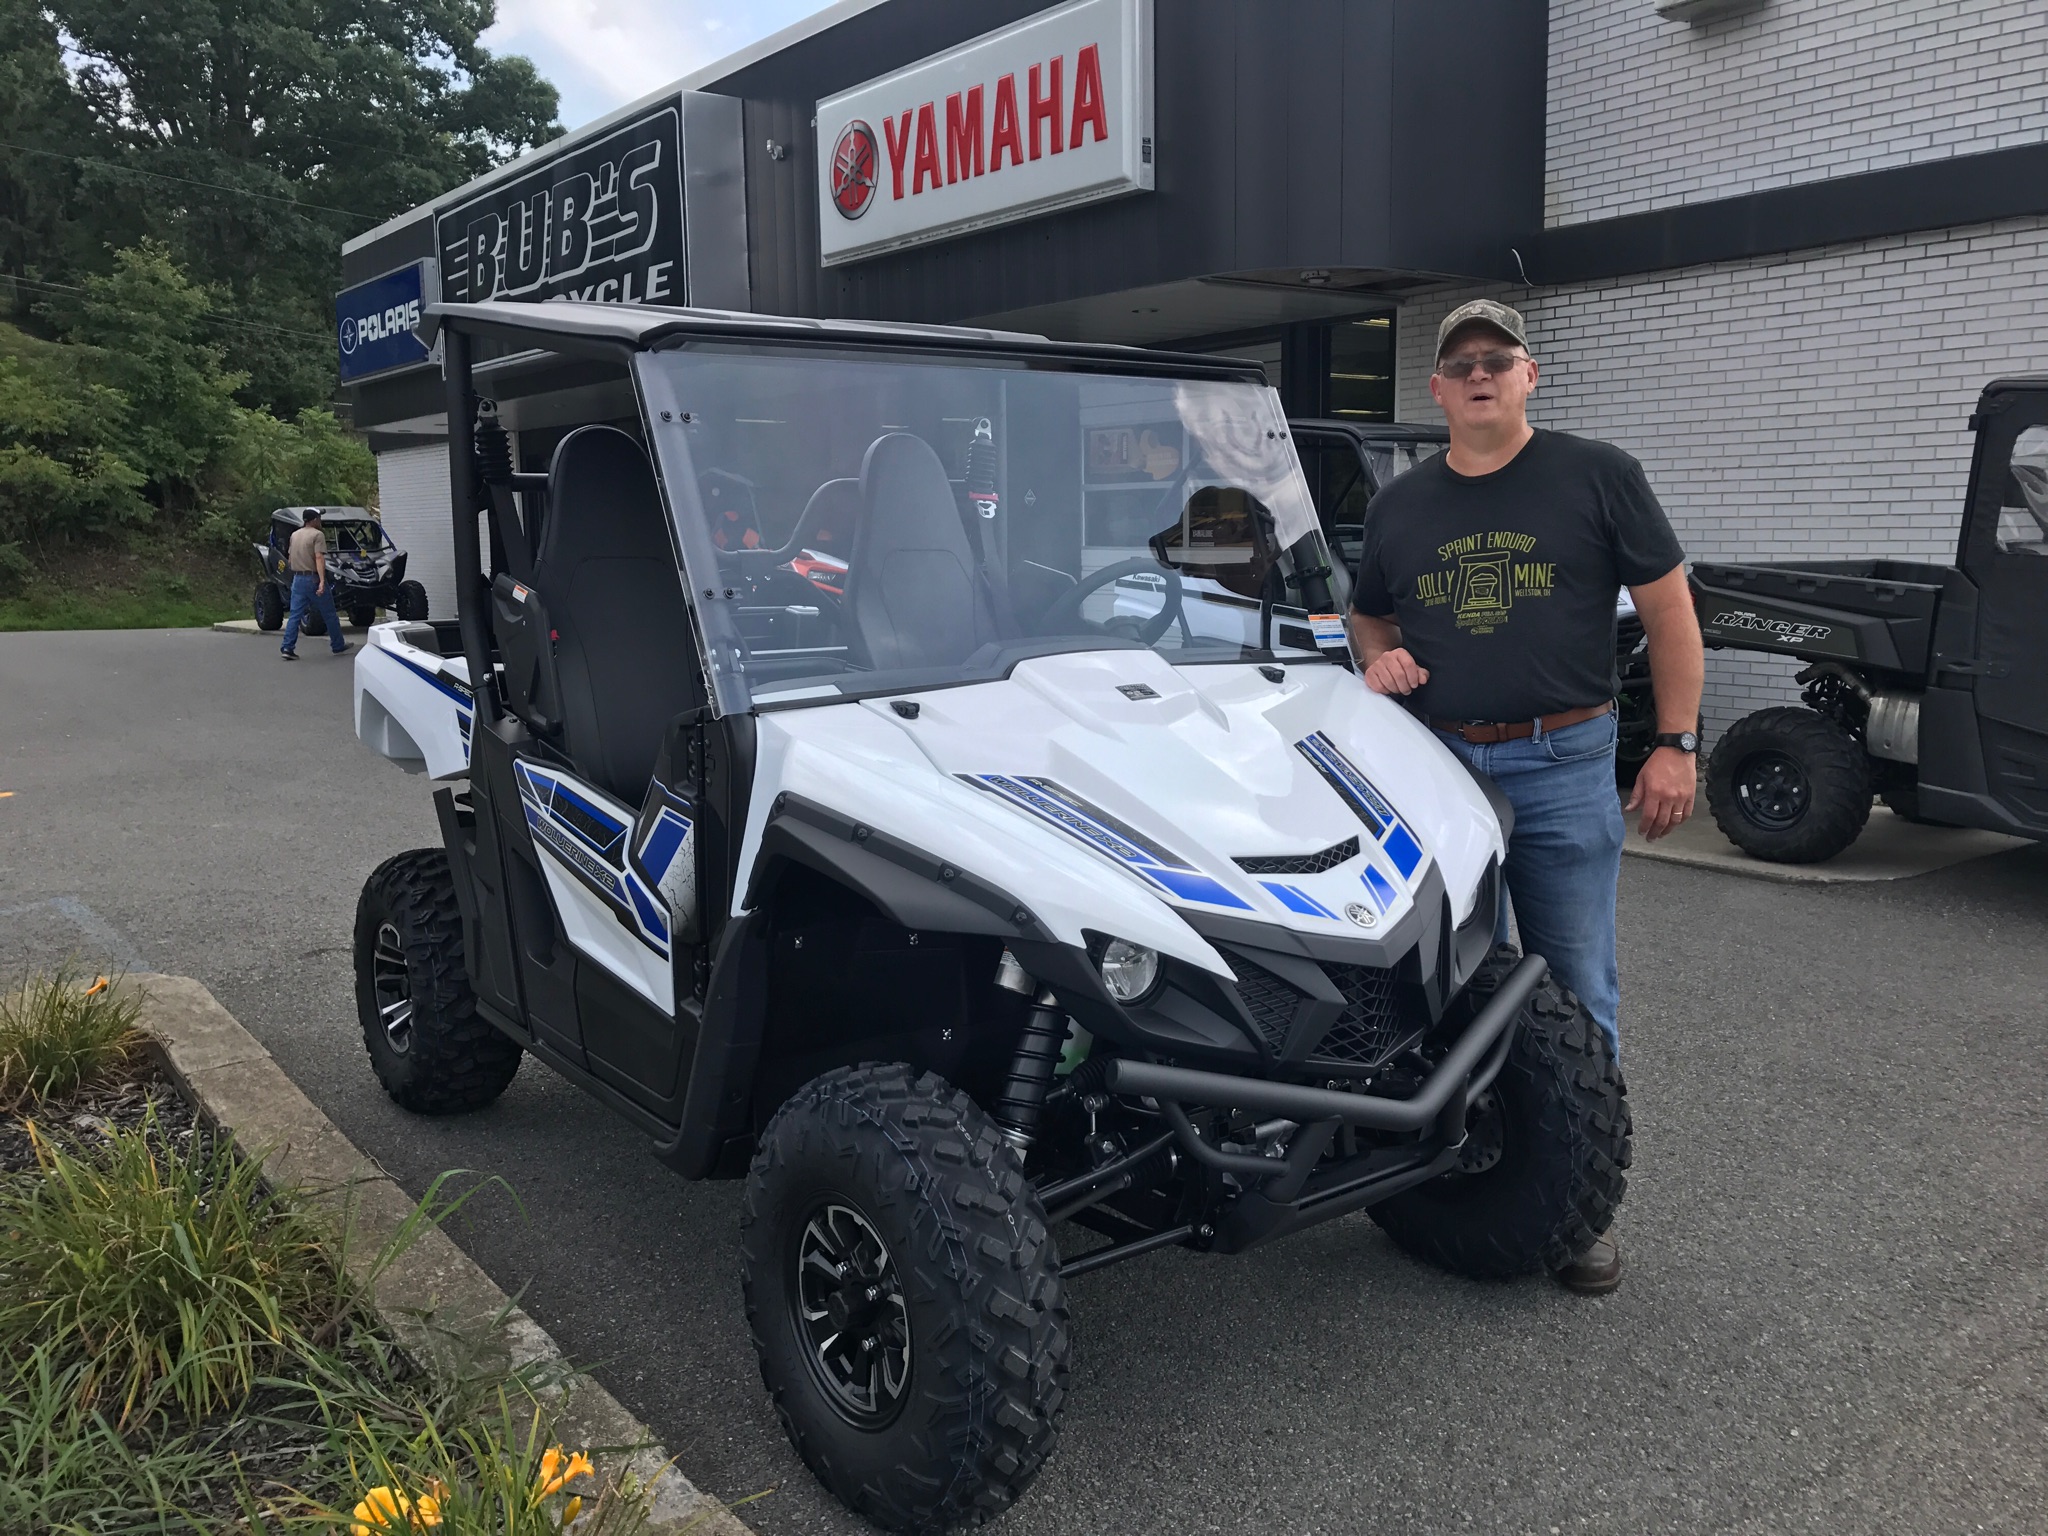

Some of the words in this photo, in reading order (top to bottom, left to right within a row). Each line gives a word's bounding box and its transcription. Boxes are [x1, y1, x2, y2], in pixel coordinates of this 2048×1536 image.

[883, 43, 1108, 201] YAMAHA
[467, 139, 661, 303] BUB'S
[357, 299, 420, 345] POLARIS
[1437, 532, 1483, 562] SPRINT
[1487, 531, 1537, 553] ENDURO
[1132, 572, 1161, 583] Kawasaki
[1416, 569, 1455, 600] JOLLY
[1515, 562, 1557, 589] MINE
[1712, 612, 1832, 639] RANGER
[1776, 634, 1804, 643] XP
[453, 682, 474, 698] R-SPEC
[989, 775, 1102, 839] WOLVERINE
[537, 815, 595, 873] WOLVERINE
[593, 864, 616, 890] X2
